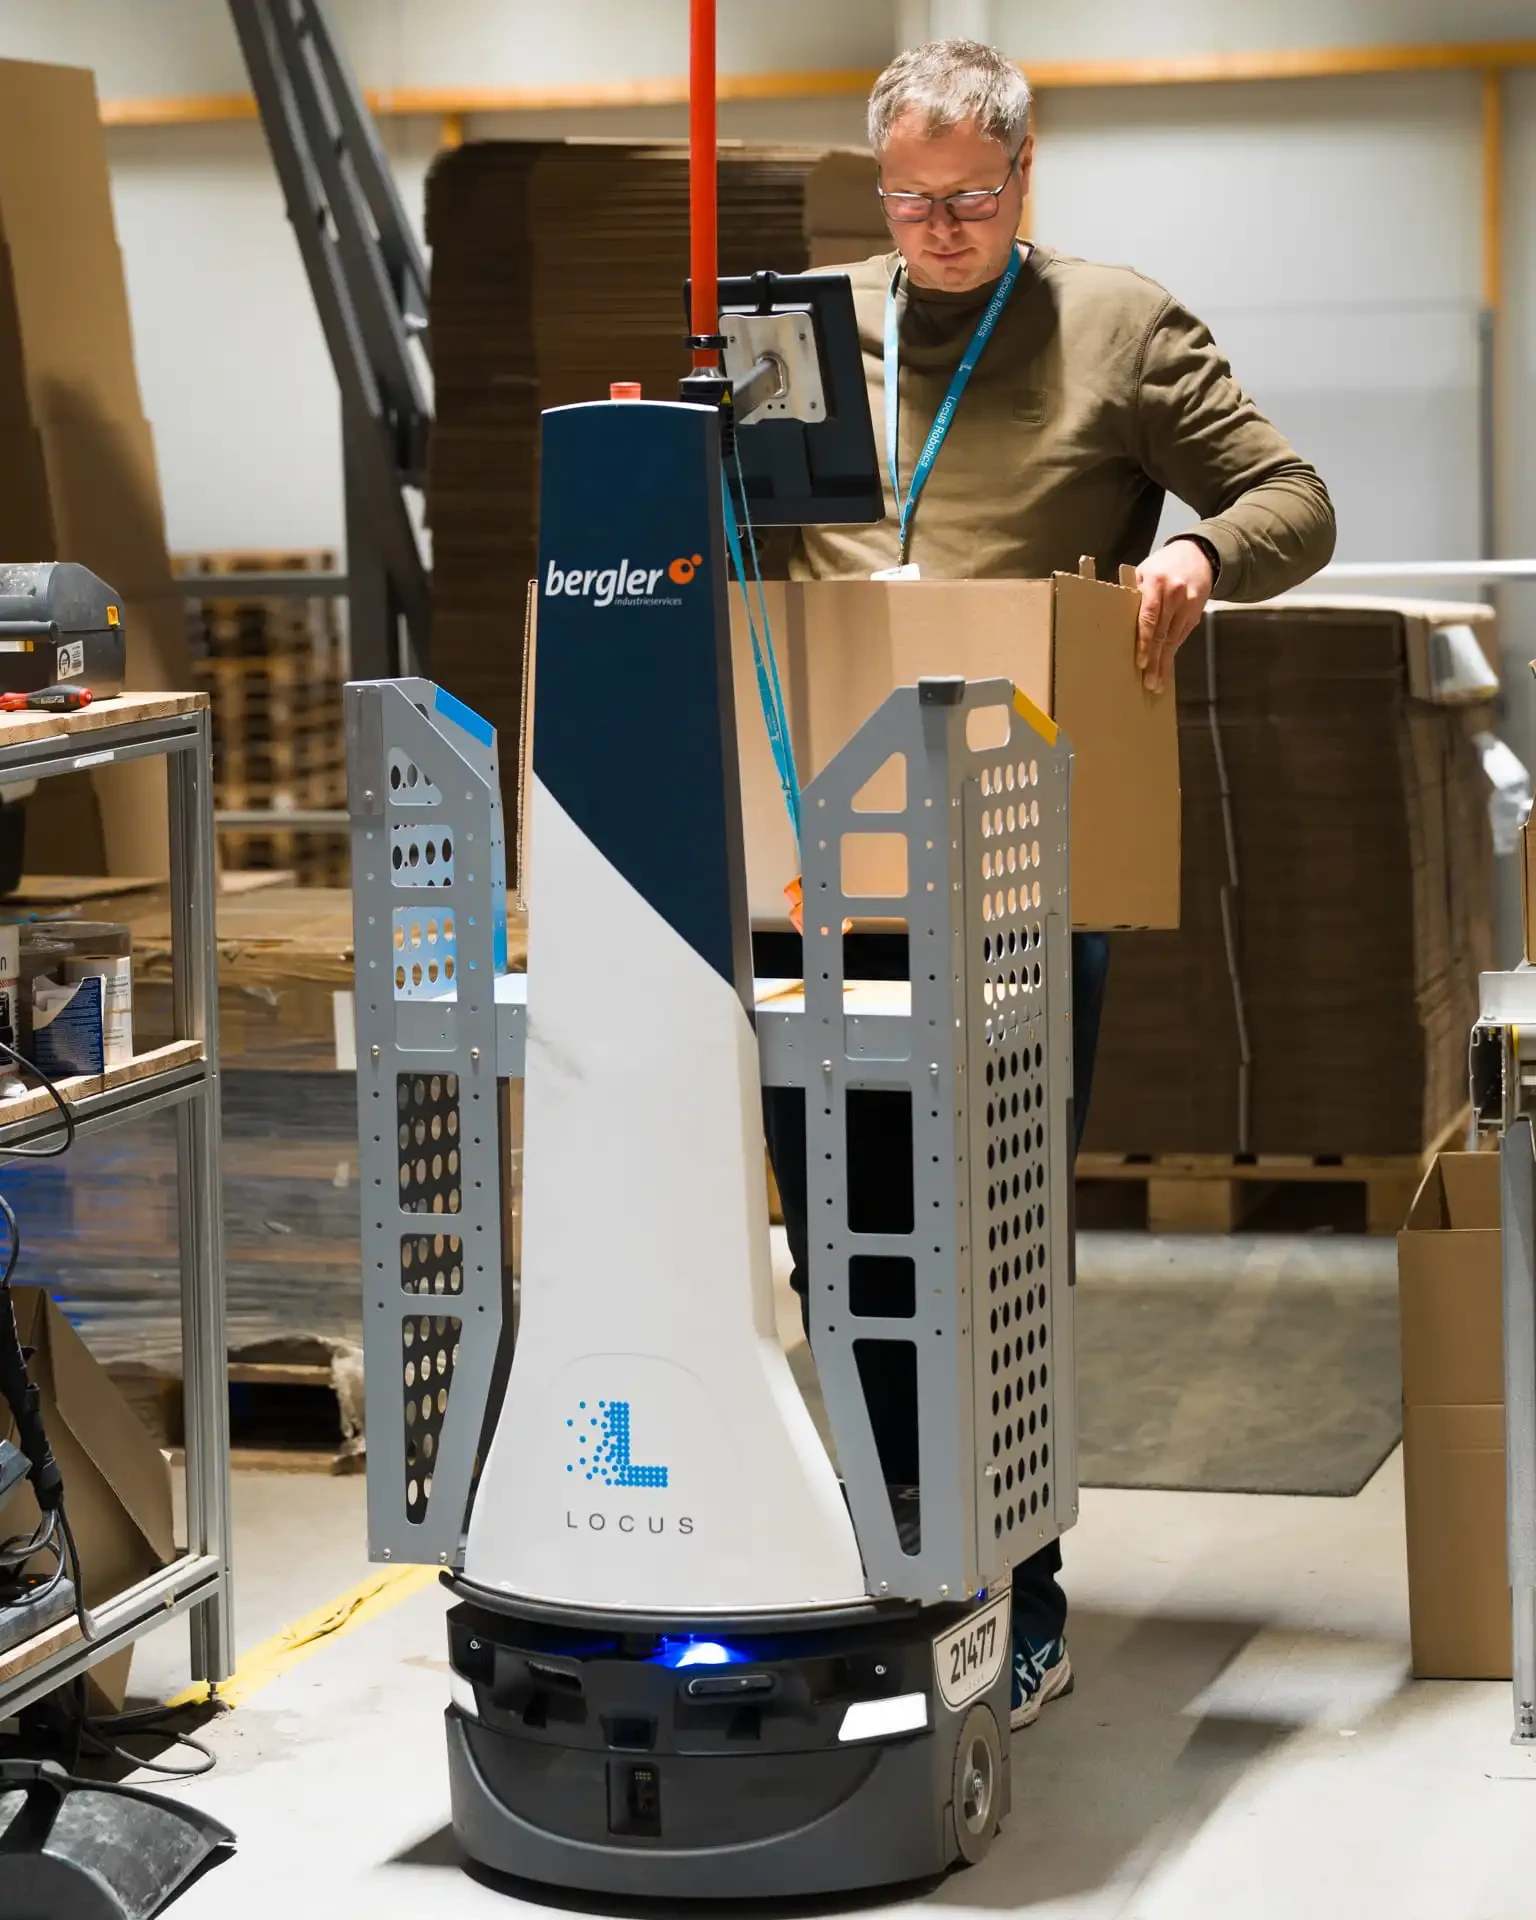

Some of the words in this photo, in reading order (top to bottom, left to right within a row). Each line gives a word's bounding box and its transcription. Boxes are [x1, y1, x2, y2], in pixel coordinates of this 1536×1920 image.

[996, 271, 1016, 299] Locus
[977, 299, 1003, 338] Robotics
[937, 395, 957, 425] Locus
[920, 424, 945, 468] Robotics
[545, 558, 664, 607] bergler
[614, 596, 683, 606] industrieservices
[566, 1511, 694, 1535] LOCUS
[950, 1616, 996, 1685] 21477
